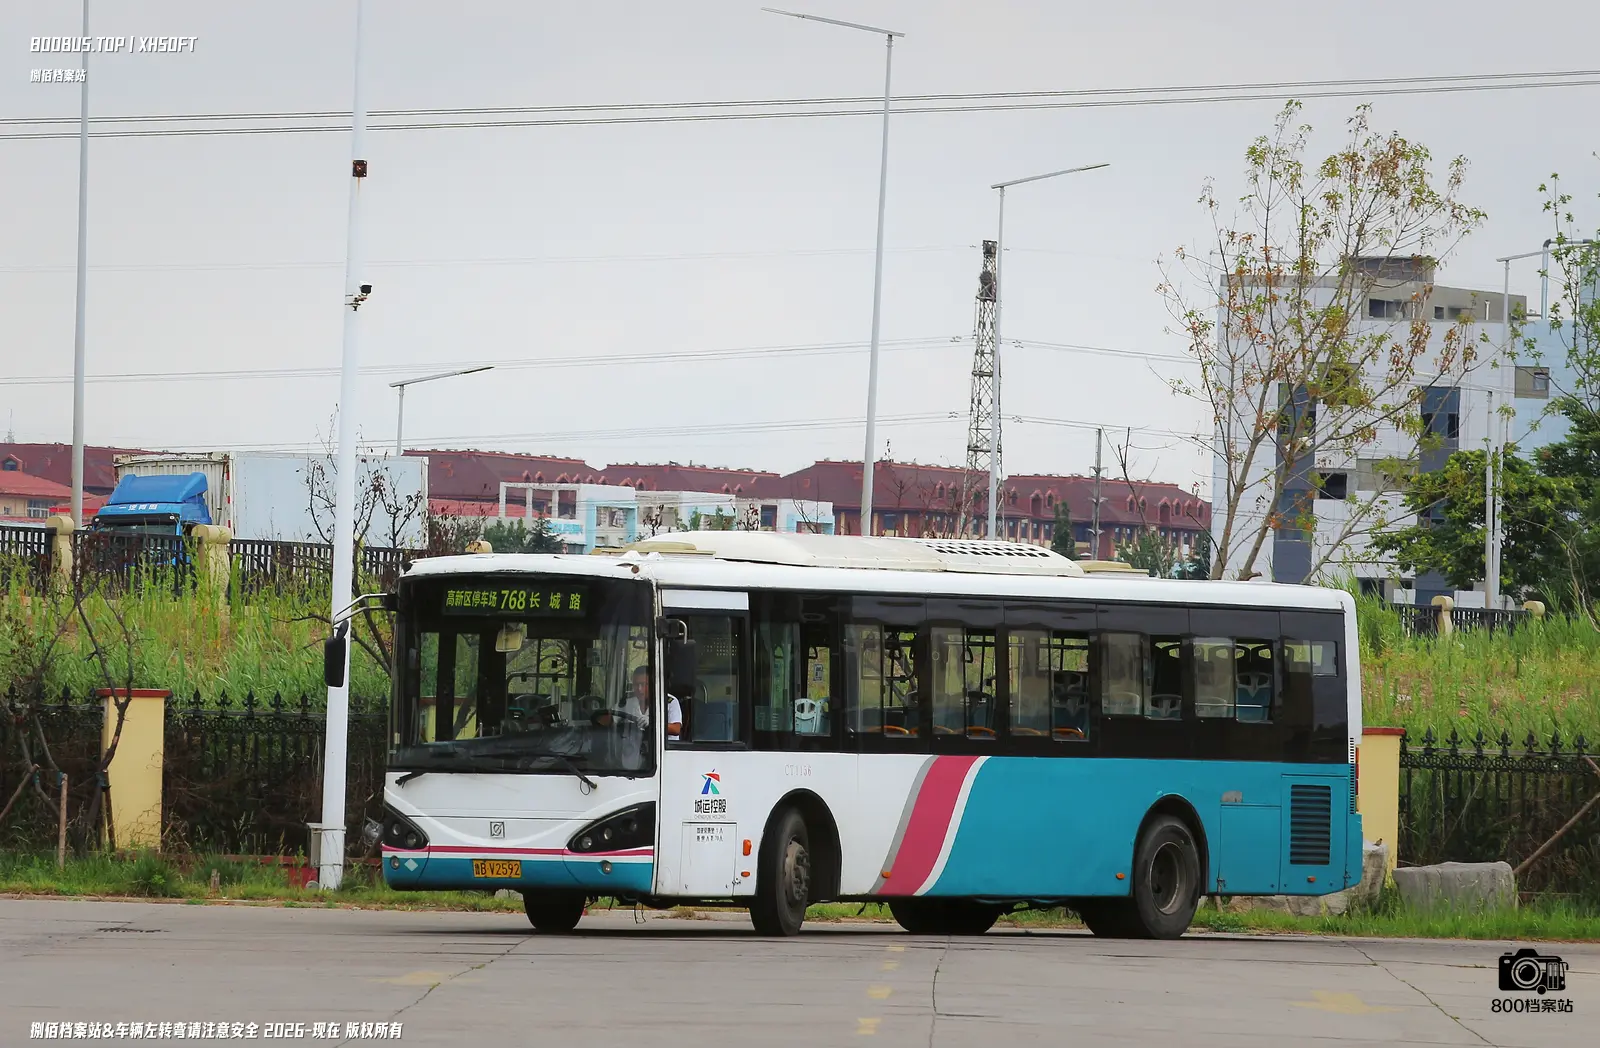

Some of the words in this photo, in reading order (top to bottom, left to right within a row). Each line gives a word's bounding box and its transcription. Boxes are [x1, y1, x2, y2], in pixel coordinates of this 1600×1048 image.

[446, 590, 497, 607] 高新区停车场
[500, 589, 527, 610] 768
[694, 798, 727, 814] 城运控股
